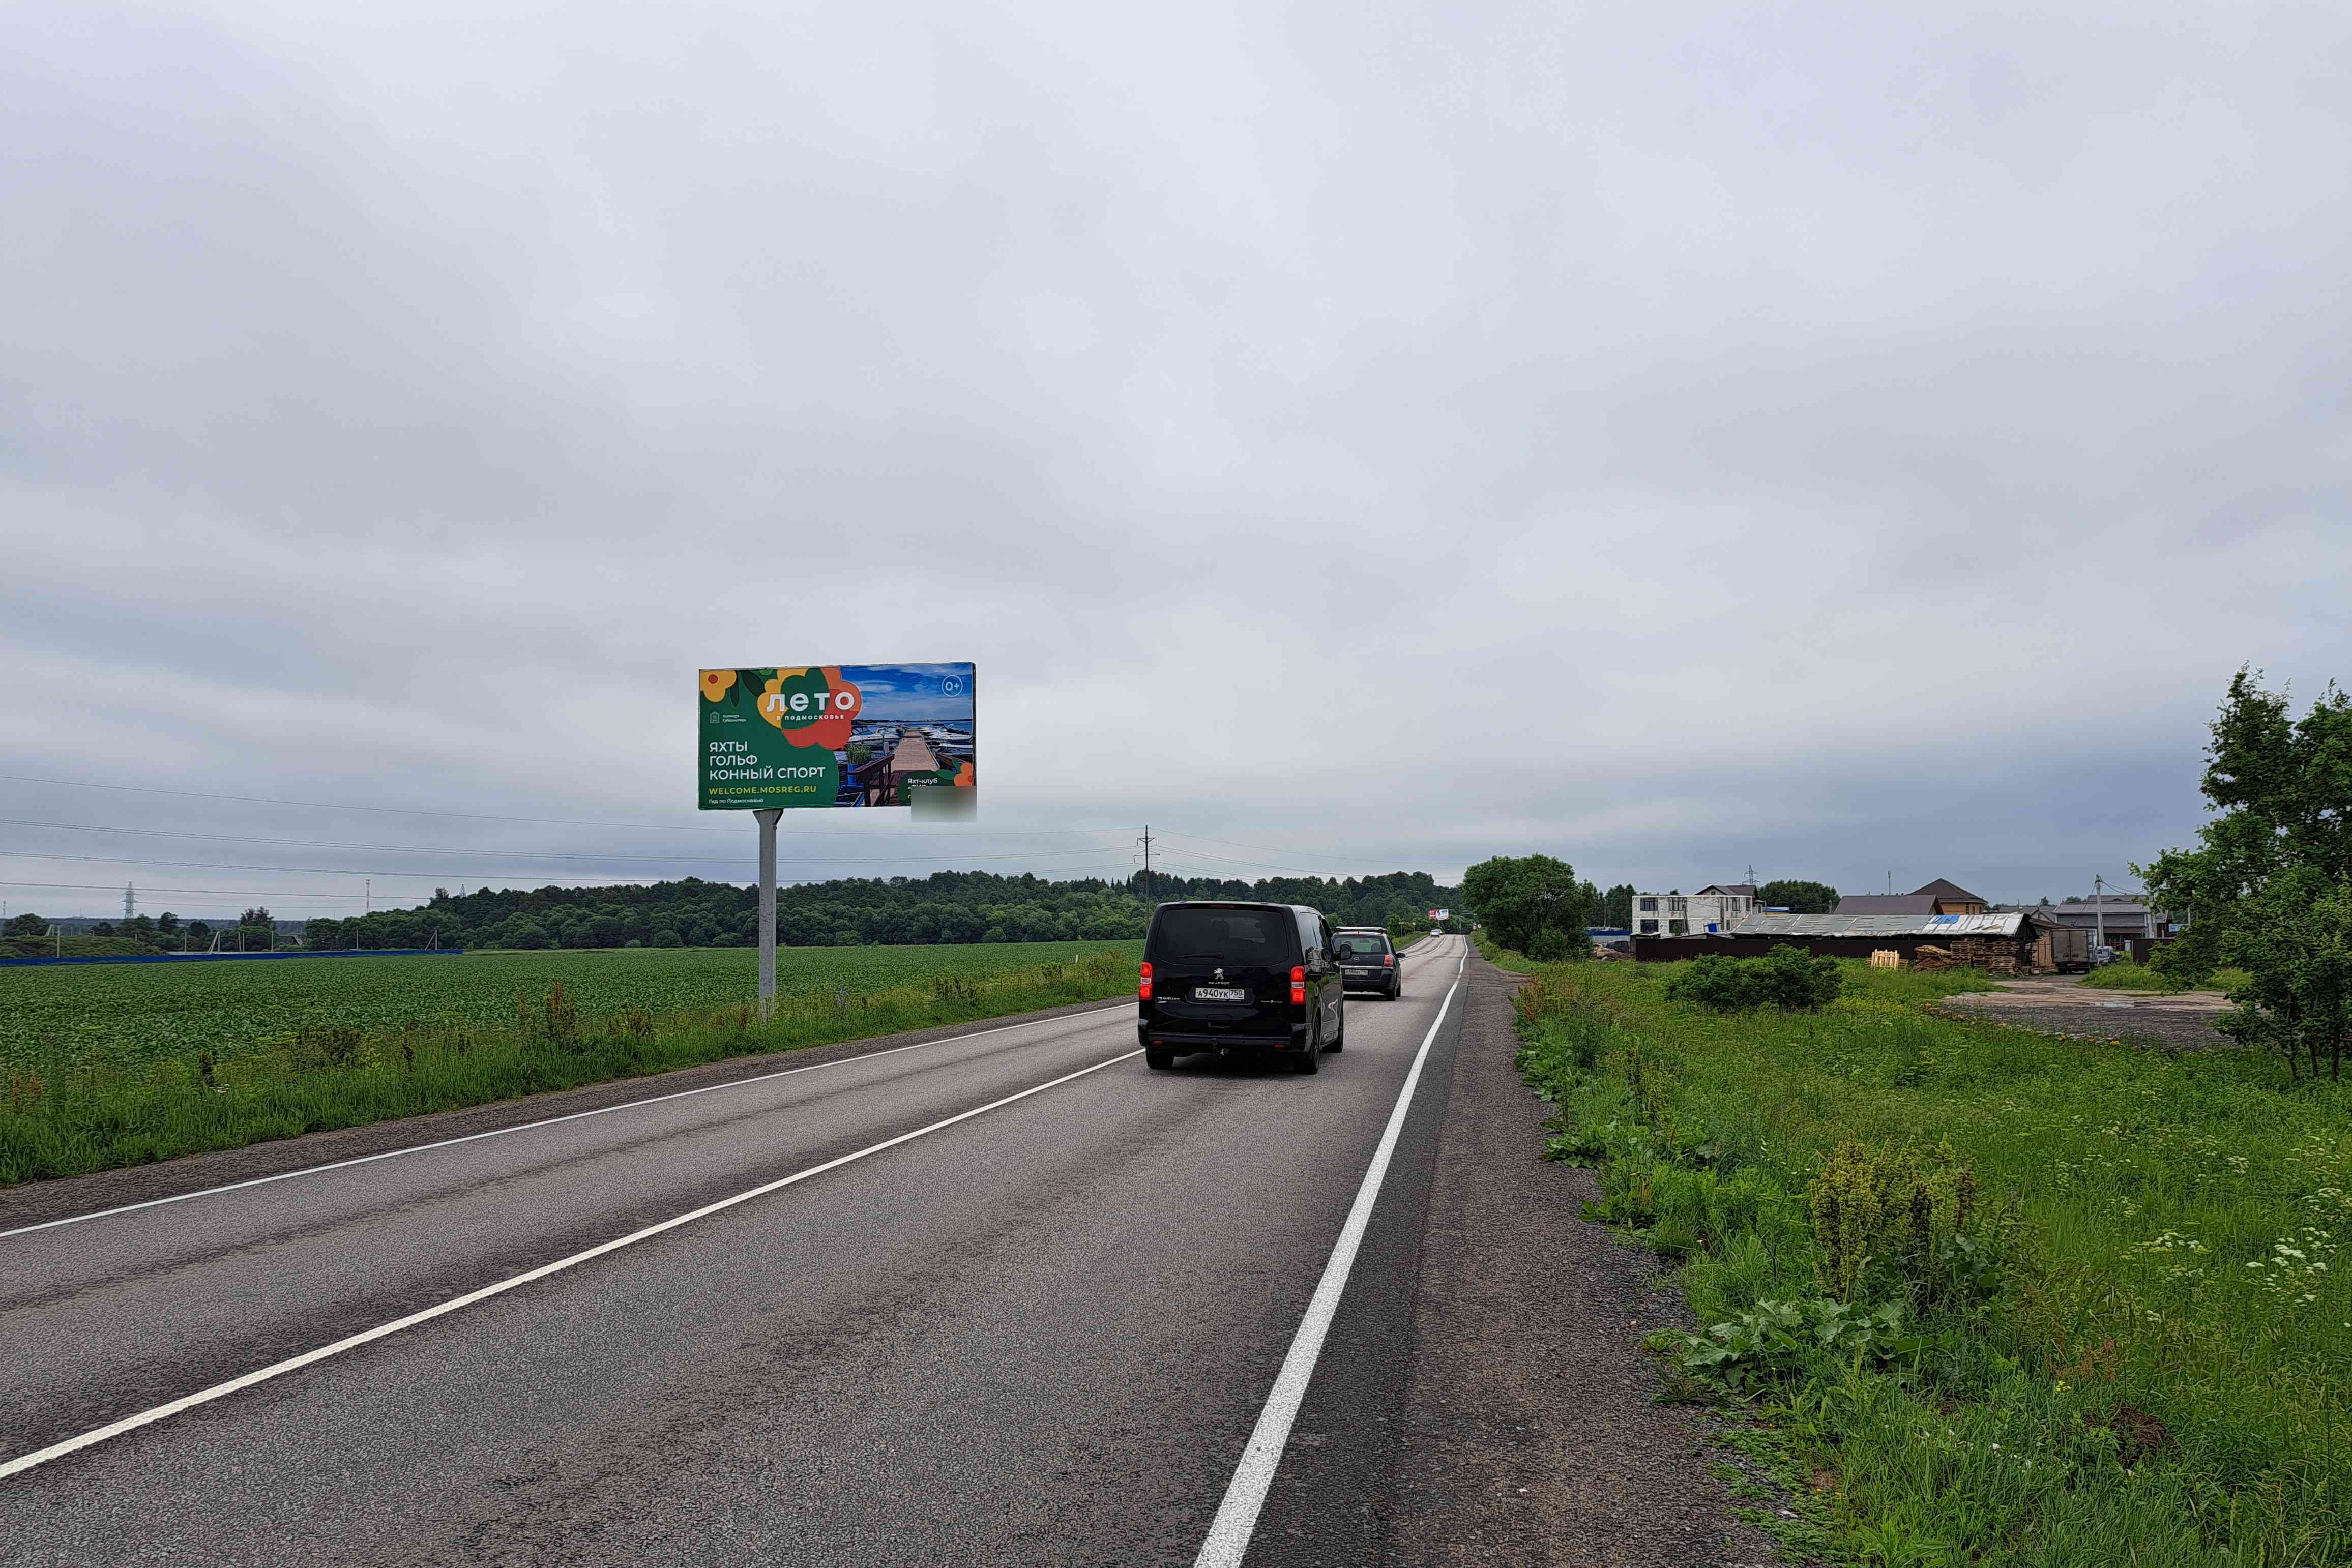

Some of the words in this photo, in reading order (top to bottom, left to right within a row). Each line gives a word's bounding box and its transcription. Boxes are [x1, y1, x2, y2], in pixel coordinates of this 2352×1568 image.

[946, 682, 960, 691] 0+
[709, 741, 748, 753] ЯХТЫ
[710, 754, 758, 767] ГОЛЬФ
[710, 765, 773, 780] КОННЫЙ
[777, 767, 826, 779] СПОРТ
[709, 786, 817, 795] WELCOME.MOSREG.RU
